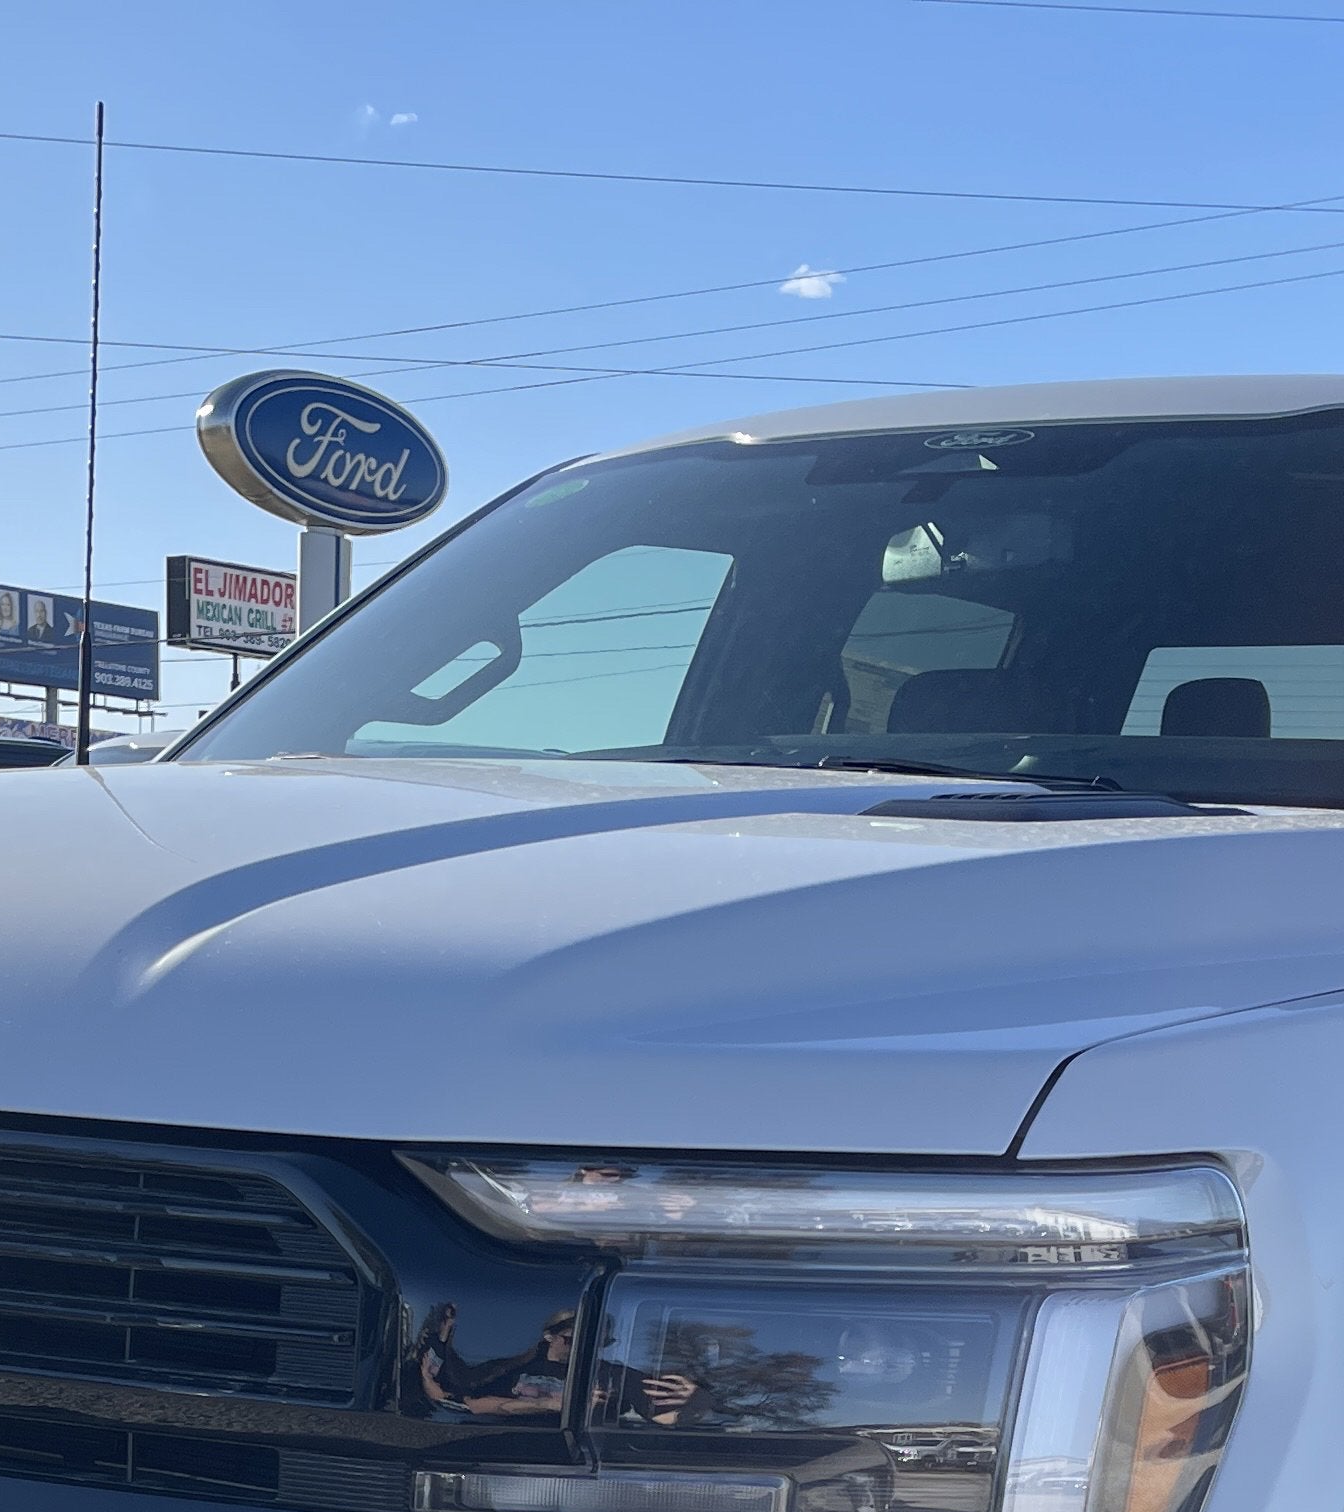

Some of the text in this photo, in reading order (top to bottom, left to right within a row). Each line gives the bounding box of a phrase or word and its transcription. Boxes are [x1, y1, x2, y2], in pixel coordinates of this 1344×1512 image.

[286, 402, 411, 501] Ford
[193, 567, 295, 609] EL JIMADOR
[196, 599, 242, 626] MEXICAN
[248, 608, 277, 631] GRILL
